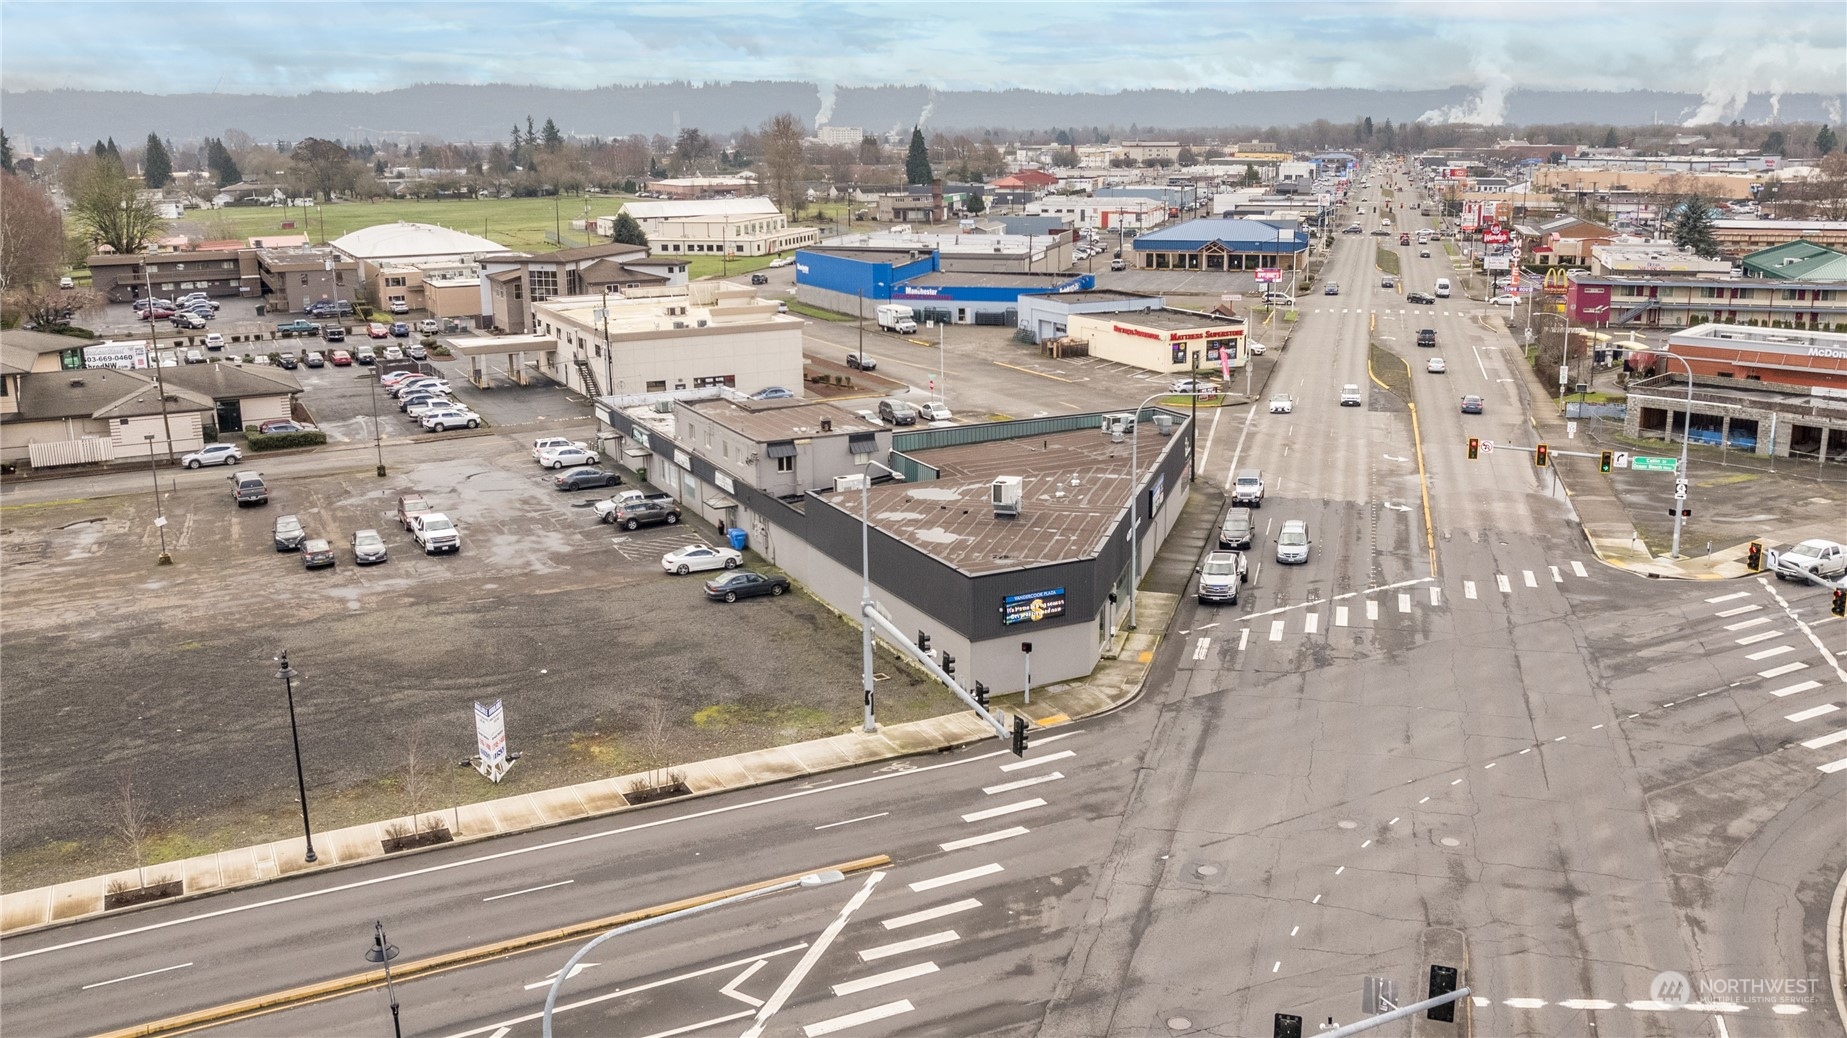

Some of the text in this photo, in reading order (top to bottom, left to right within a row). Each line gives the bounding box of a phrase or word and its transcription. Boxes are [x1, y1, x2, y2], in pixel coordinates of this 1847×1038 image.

[1484, 233, 1507, 243] Wendy's
[1511, 239, 1522, 285] MOTEL
[905, 286, 938, 296] Manchester
[1808, 347, 1847, 359] McDon
[85, 354, 133, 363] 03-669-0460
